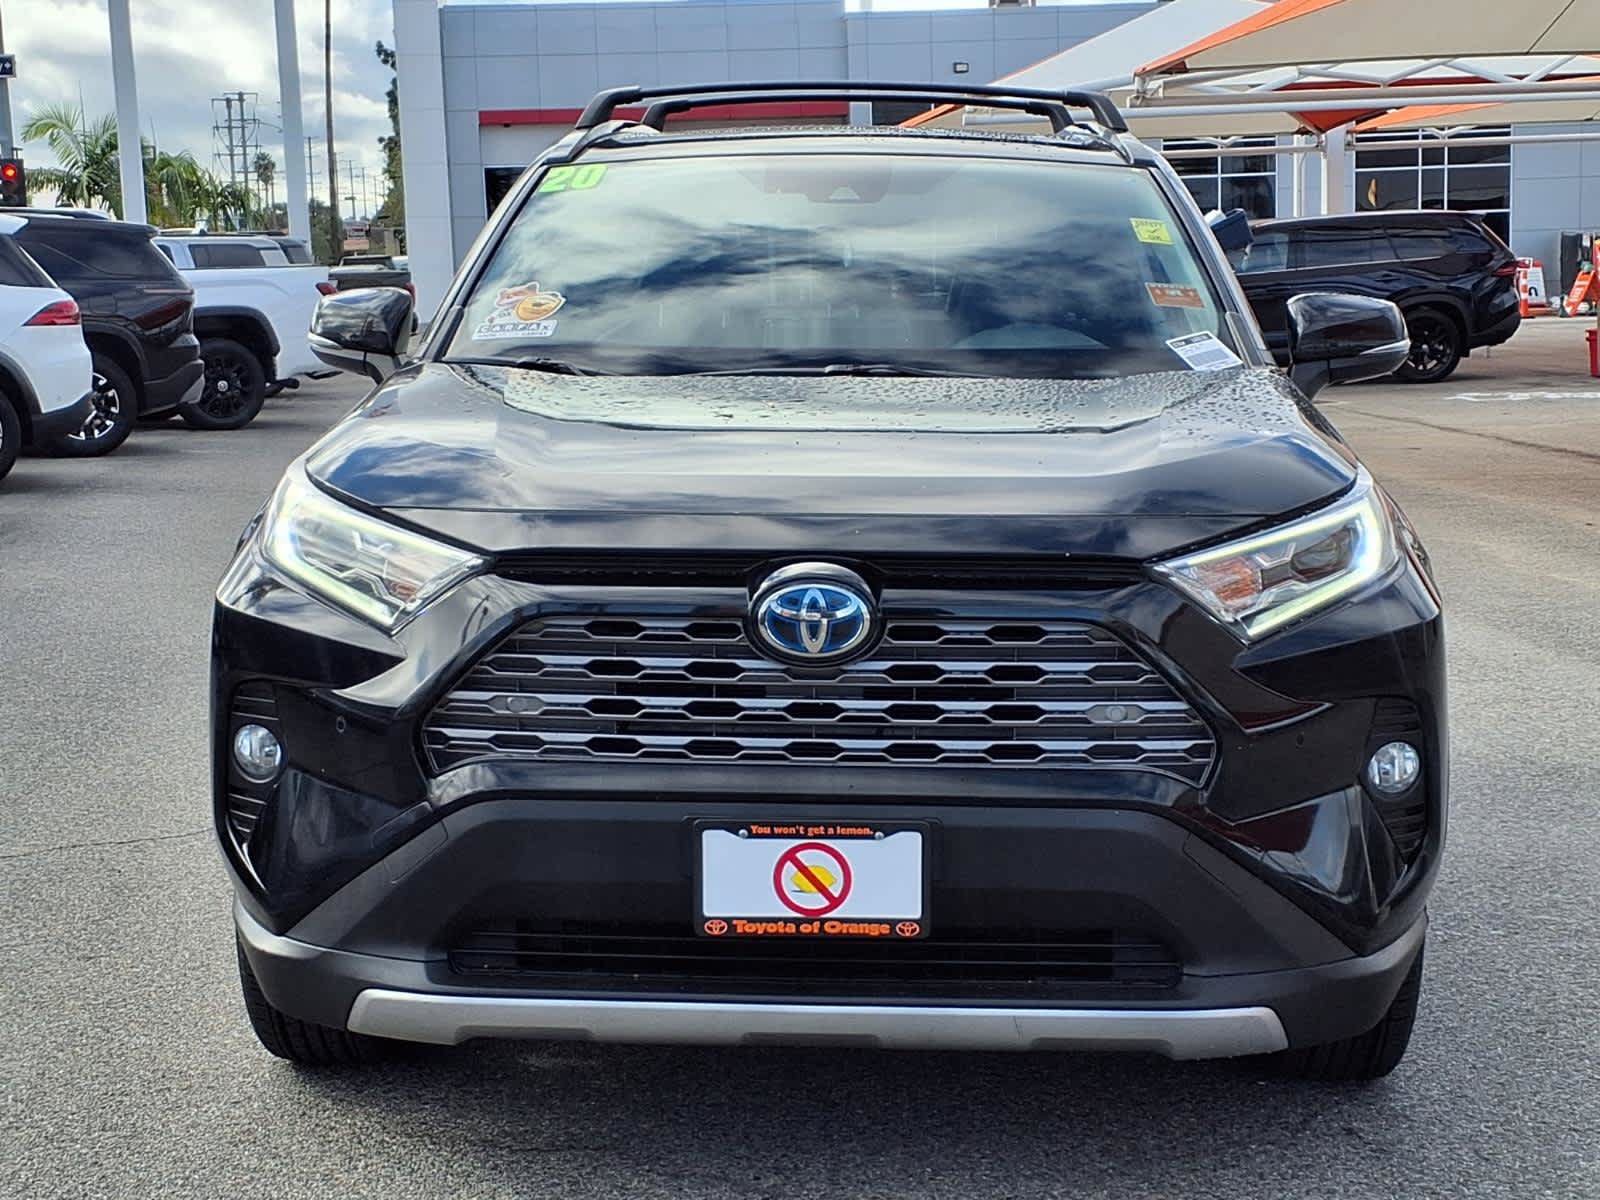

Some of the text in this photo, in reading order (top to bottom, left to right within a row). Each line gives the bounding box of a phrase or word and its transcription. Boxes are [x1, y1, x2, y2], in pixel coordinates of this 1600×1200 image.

[539, 165, 607, 192] 20
[750, 825, 874, 836] You won't get a lemon.
[732, 920, 890, 936] Toyota of Orange
